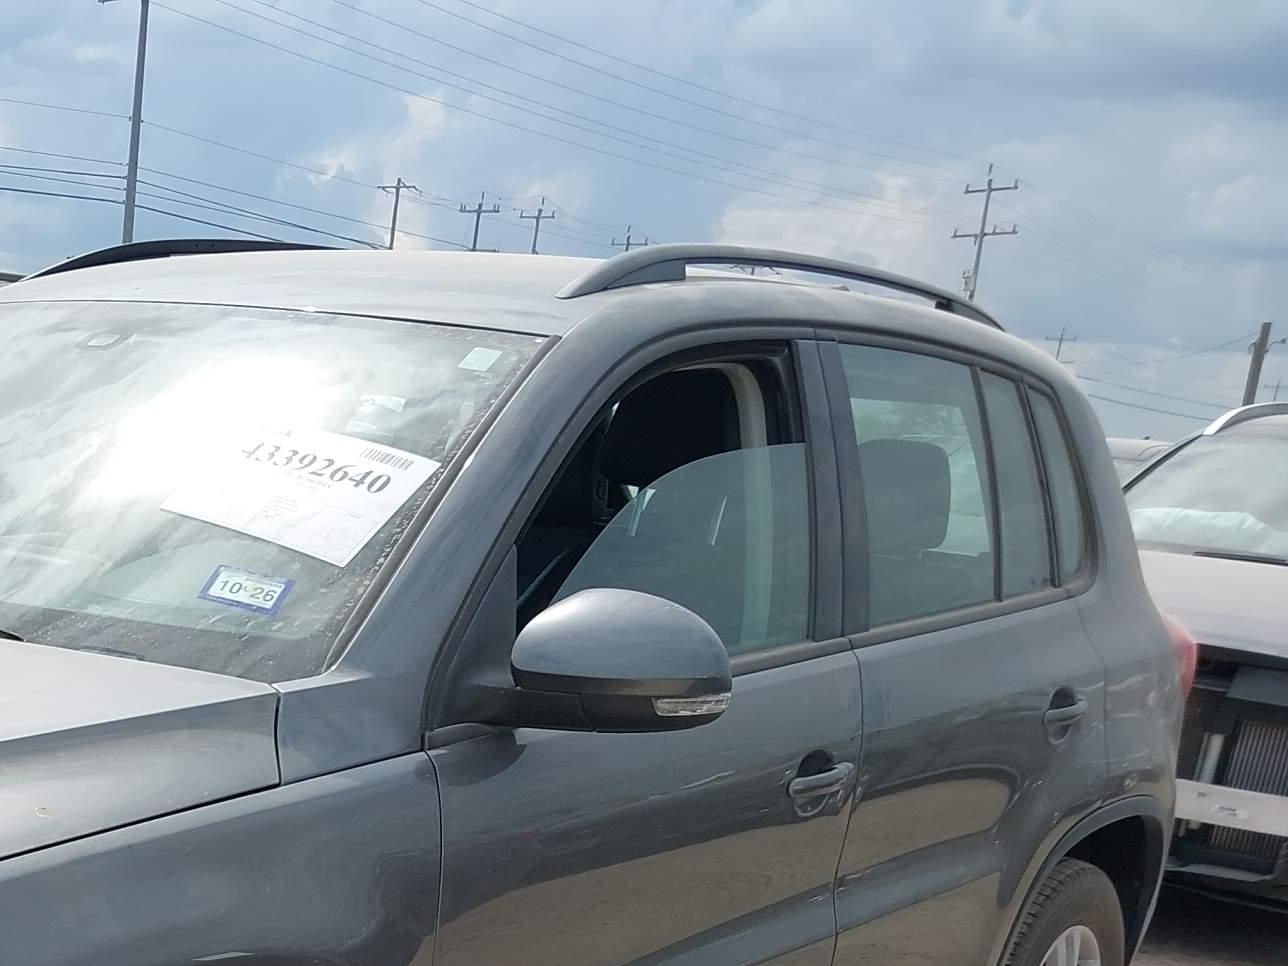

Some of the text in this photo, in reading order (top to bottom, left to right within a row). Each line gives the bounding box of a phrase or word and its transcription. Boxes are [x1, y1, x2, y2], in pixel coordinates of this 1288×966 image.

[241, 442, 391, 493] 43392640
[219, 580, 277, 602] 10 26
